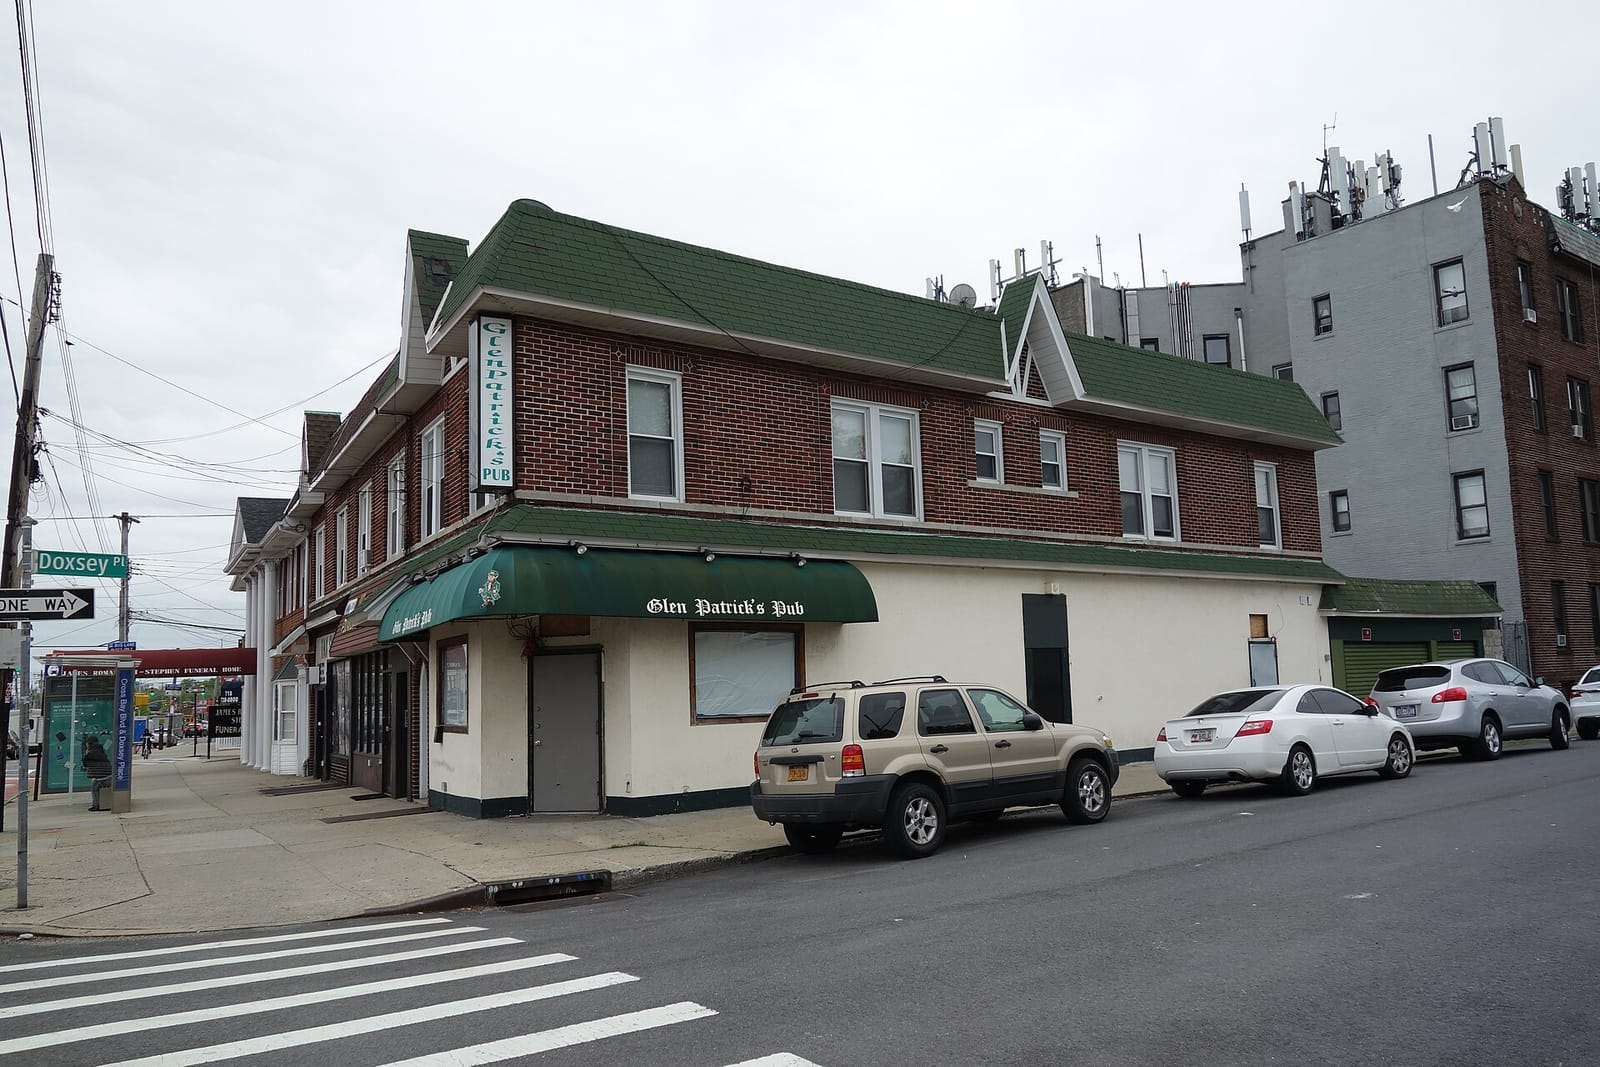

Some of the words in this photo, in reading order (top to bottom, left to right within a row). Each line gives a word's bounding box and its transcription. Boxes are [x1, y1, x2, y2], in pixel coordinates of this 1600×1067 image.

[482, 468, 510, 481] PUB
[39, 553, 108, 576] Doxsey
[113, 556, 125, 567] Pl
[45, 599, 78, 611] WAY
[646, 598, 688, 614] Glen
[694, 598, 765, 617] Patrick's
[771, 600, 805, 617] Pub
[120, 678, 128, 698] Cross
[119, 699, 127, 712] Bay
[216, 708, 236, 716] JAMES
[119, 713, 127, 728] Blvd
[215, 725, 241, 734] FUNER
[117, 736, 126, 760] Doxsey
[117, 761, 125, 780] Place
